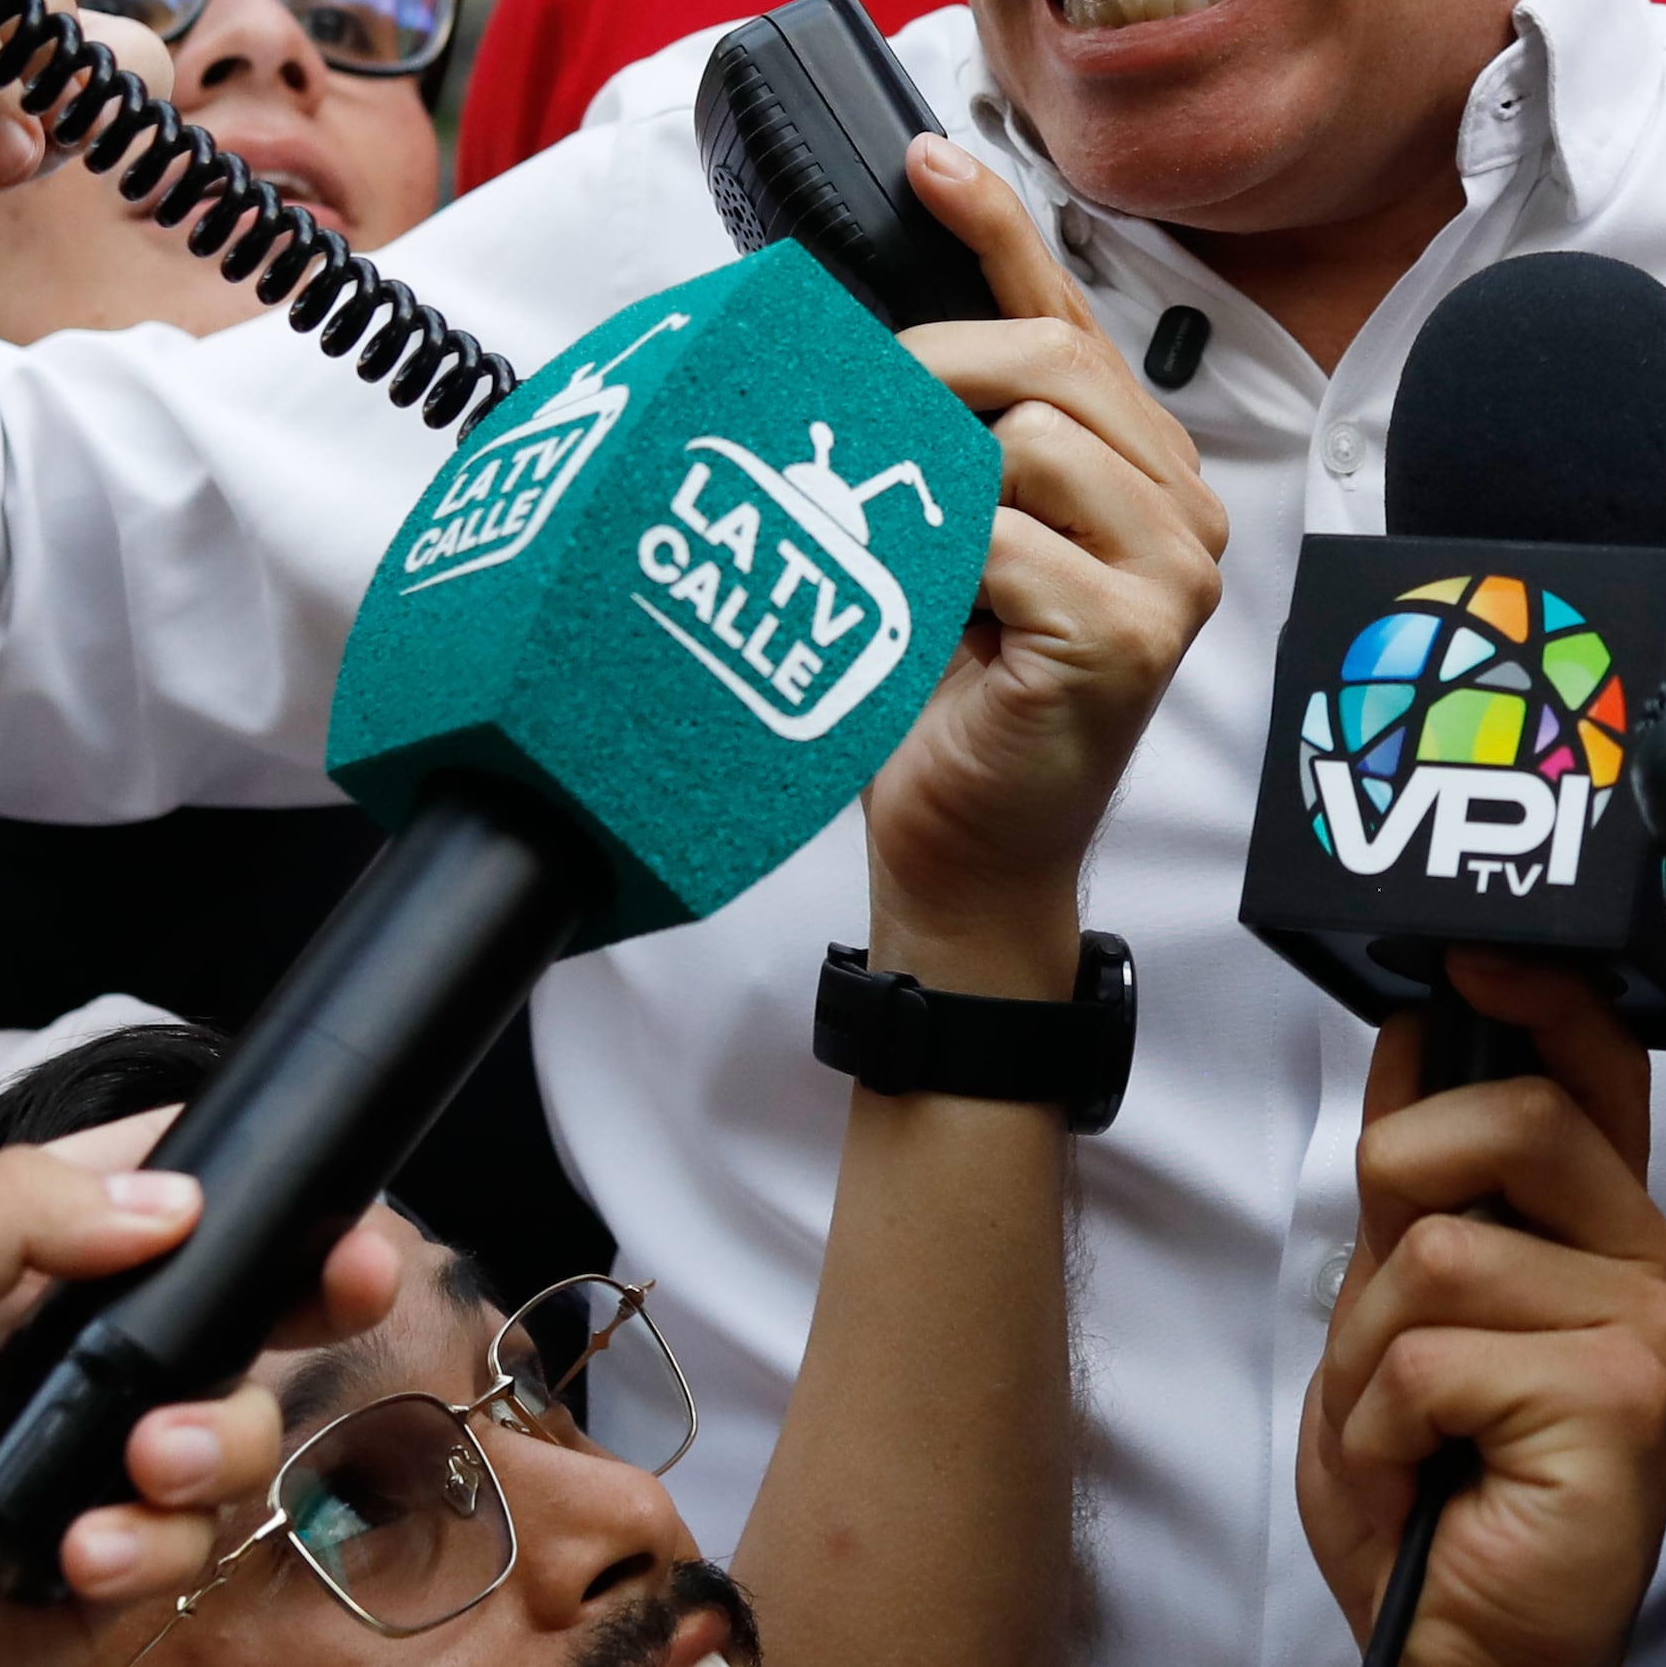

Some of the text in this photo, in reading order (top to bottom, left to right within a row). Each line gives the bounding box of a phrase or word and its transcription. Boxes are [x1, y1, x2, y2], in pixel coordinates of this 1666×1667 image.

[434, 430, 585, 520] LA TV
[404, 486, 541, 573] CALLE
[670, 462, 865, 647] LA TV
[637, 524, 823, 707] CALLE
[1314, 760, 1592, 886] VPI
[1467, 860, 1544, 896] TV
